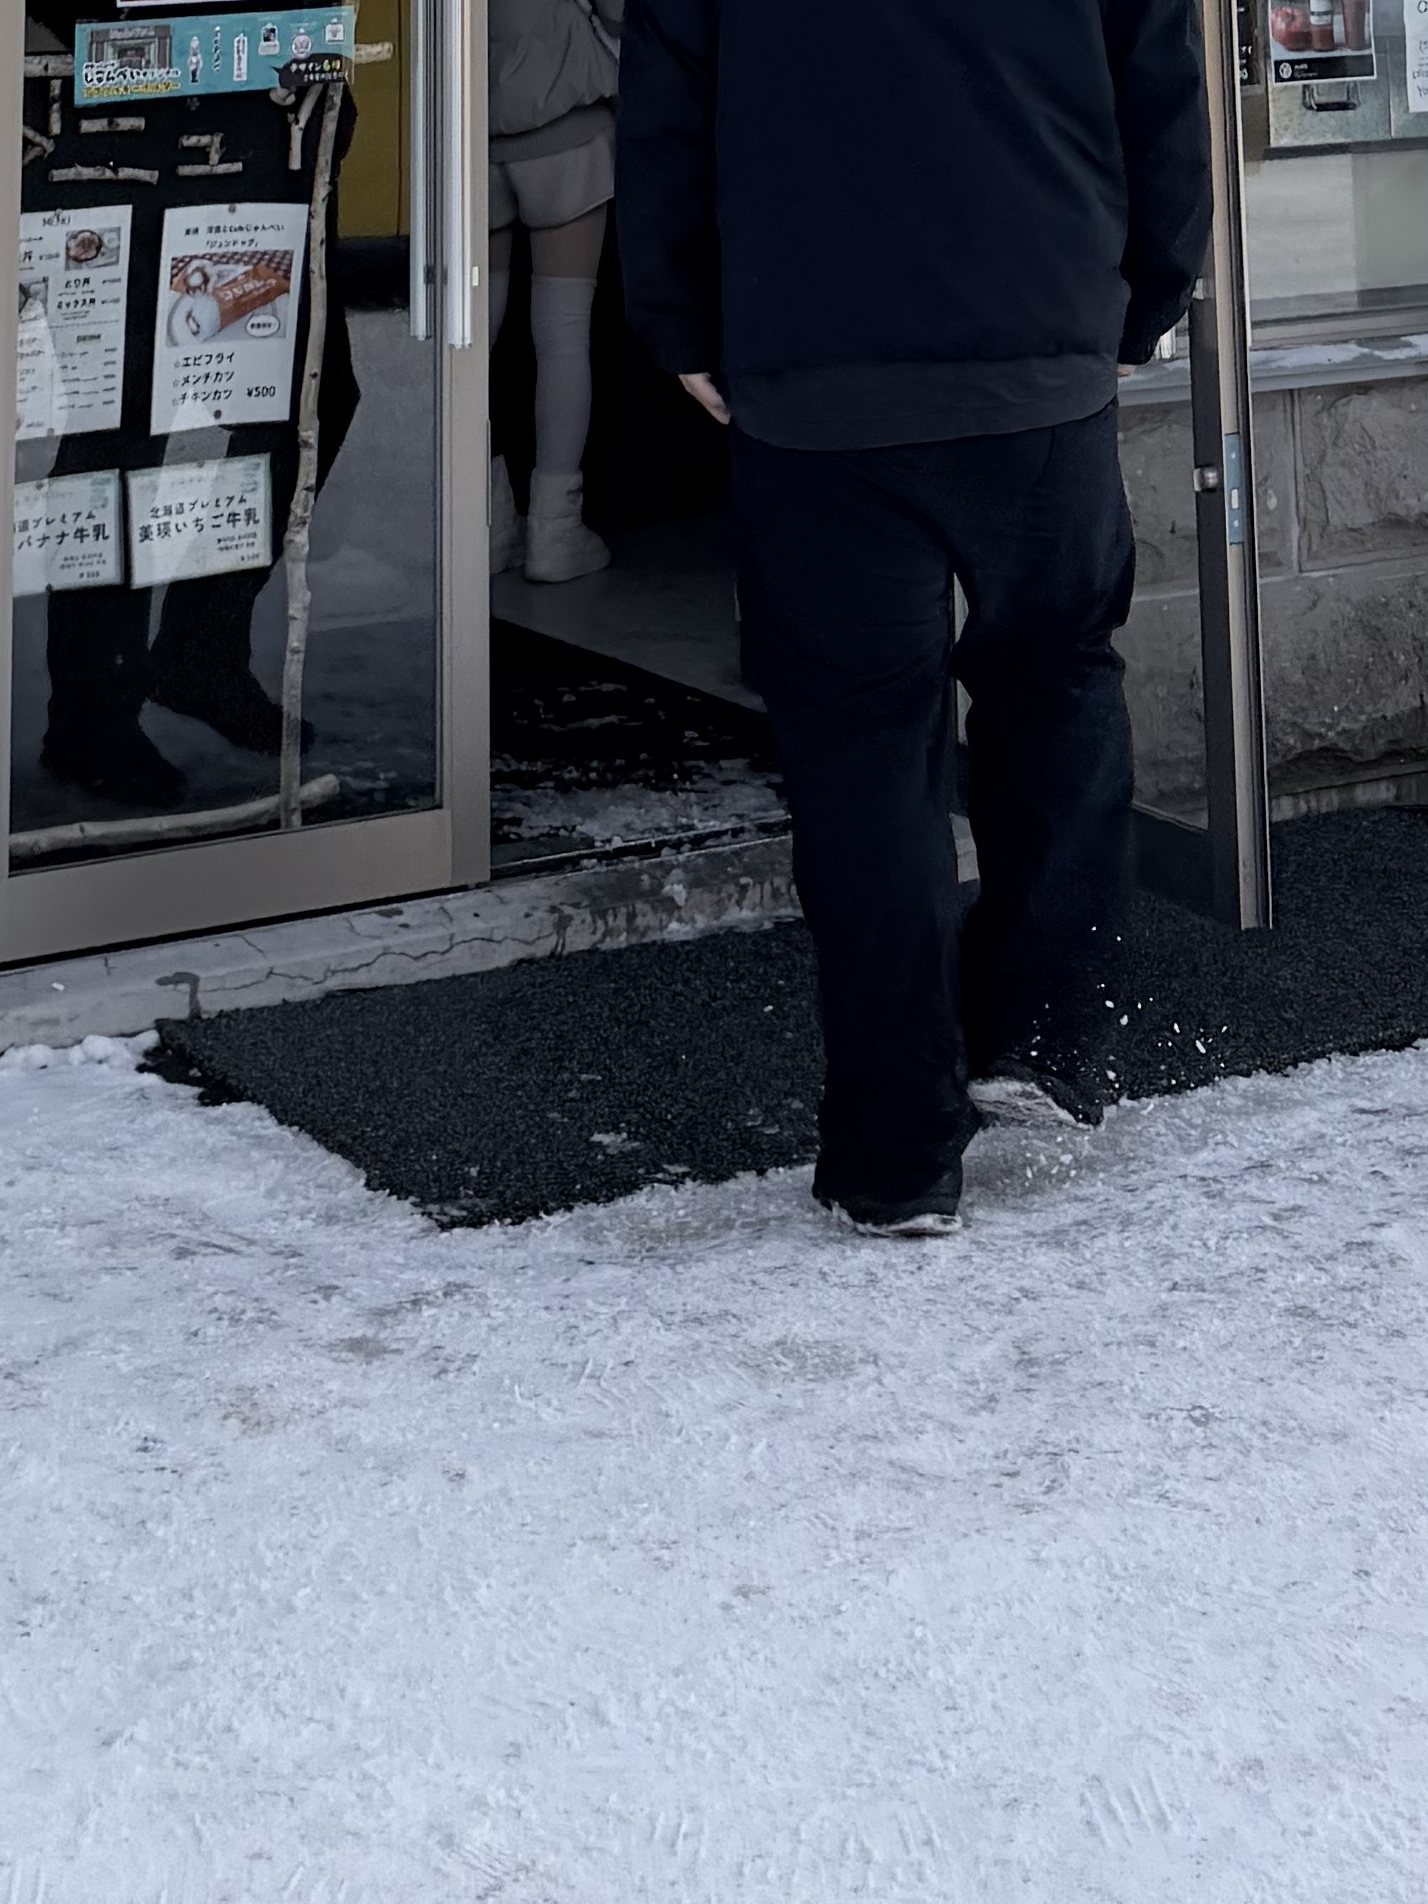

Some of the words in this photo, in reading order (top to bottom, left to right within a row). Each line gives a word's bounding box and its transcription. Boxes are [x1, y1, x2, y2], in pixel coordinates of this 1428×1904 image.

[182, 352, 235, 368] エビフライ
[181, 371, 235, 386] メンチカツ
[246, 385, 276, 398] ¥500
